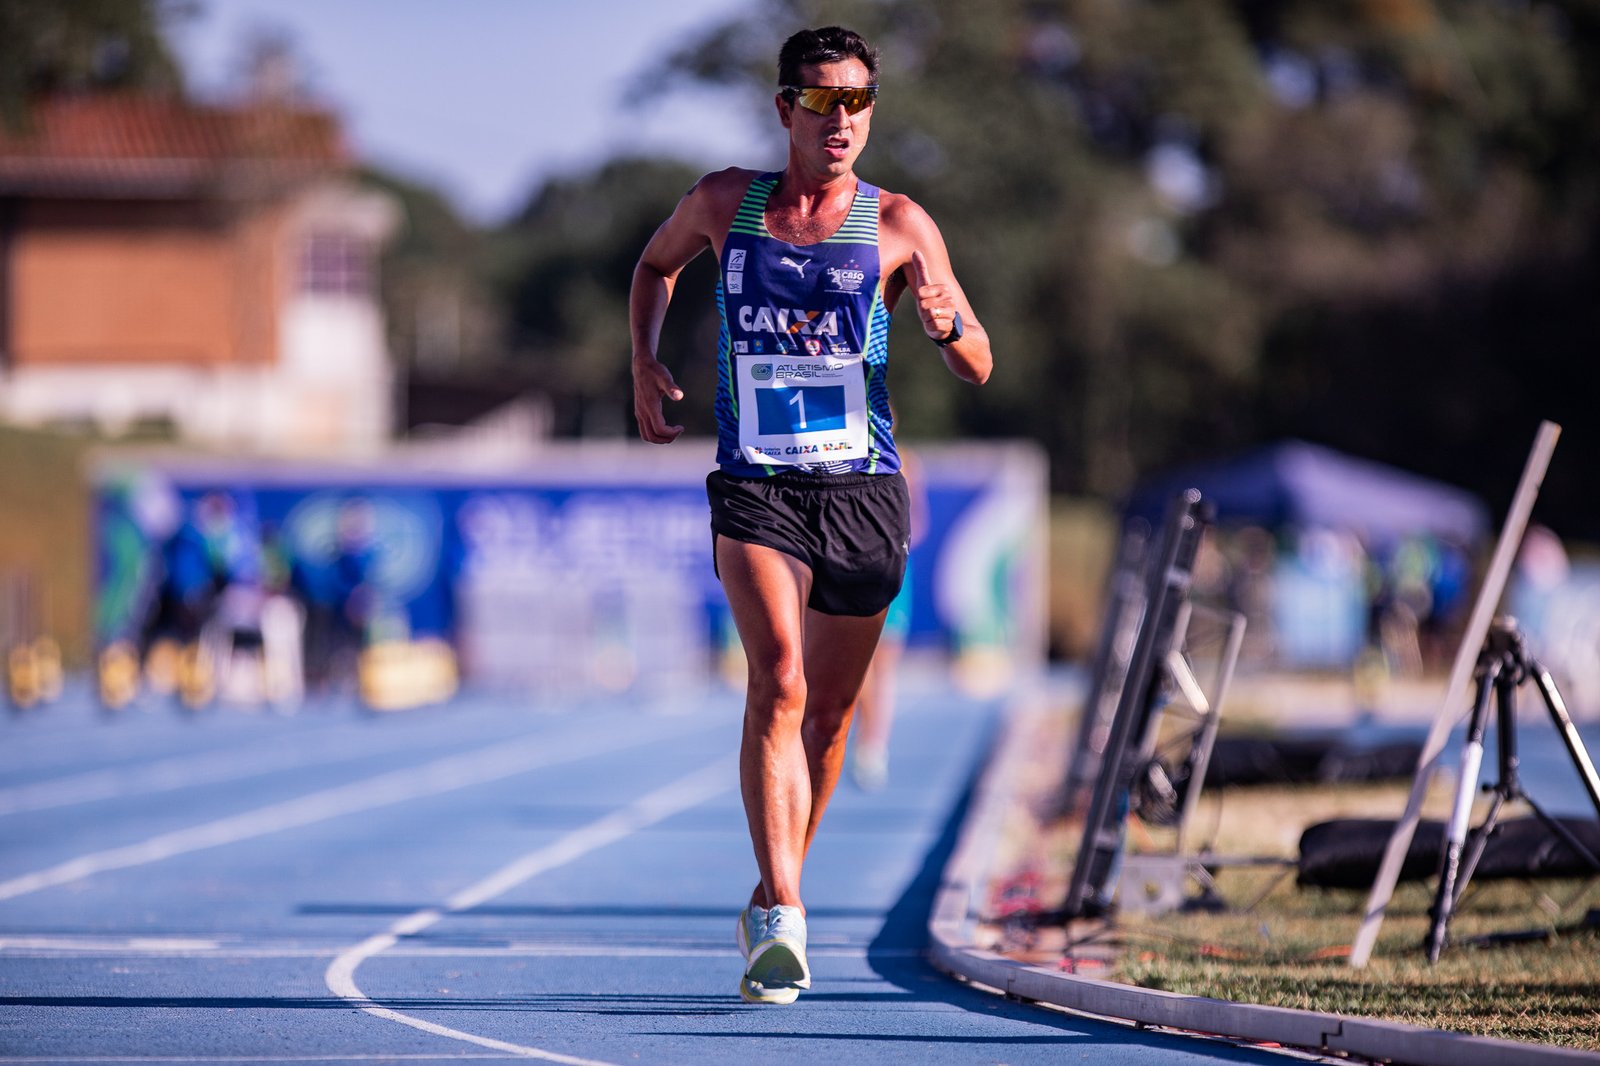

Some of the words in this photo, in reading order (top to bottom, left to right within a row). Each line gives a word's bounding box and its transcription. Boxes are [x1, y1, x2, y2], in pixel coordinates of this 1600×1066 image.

[739, 305, 839, 336] CAIXA
[776, 363, 844, 372] ATLETISMO
[776, 371, 821, 379] BRASIL
[789, 389, 807, 429] 1
[785, 444, 819, 455] CAIXA
